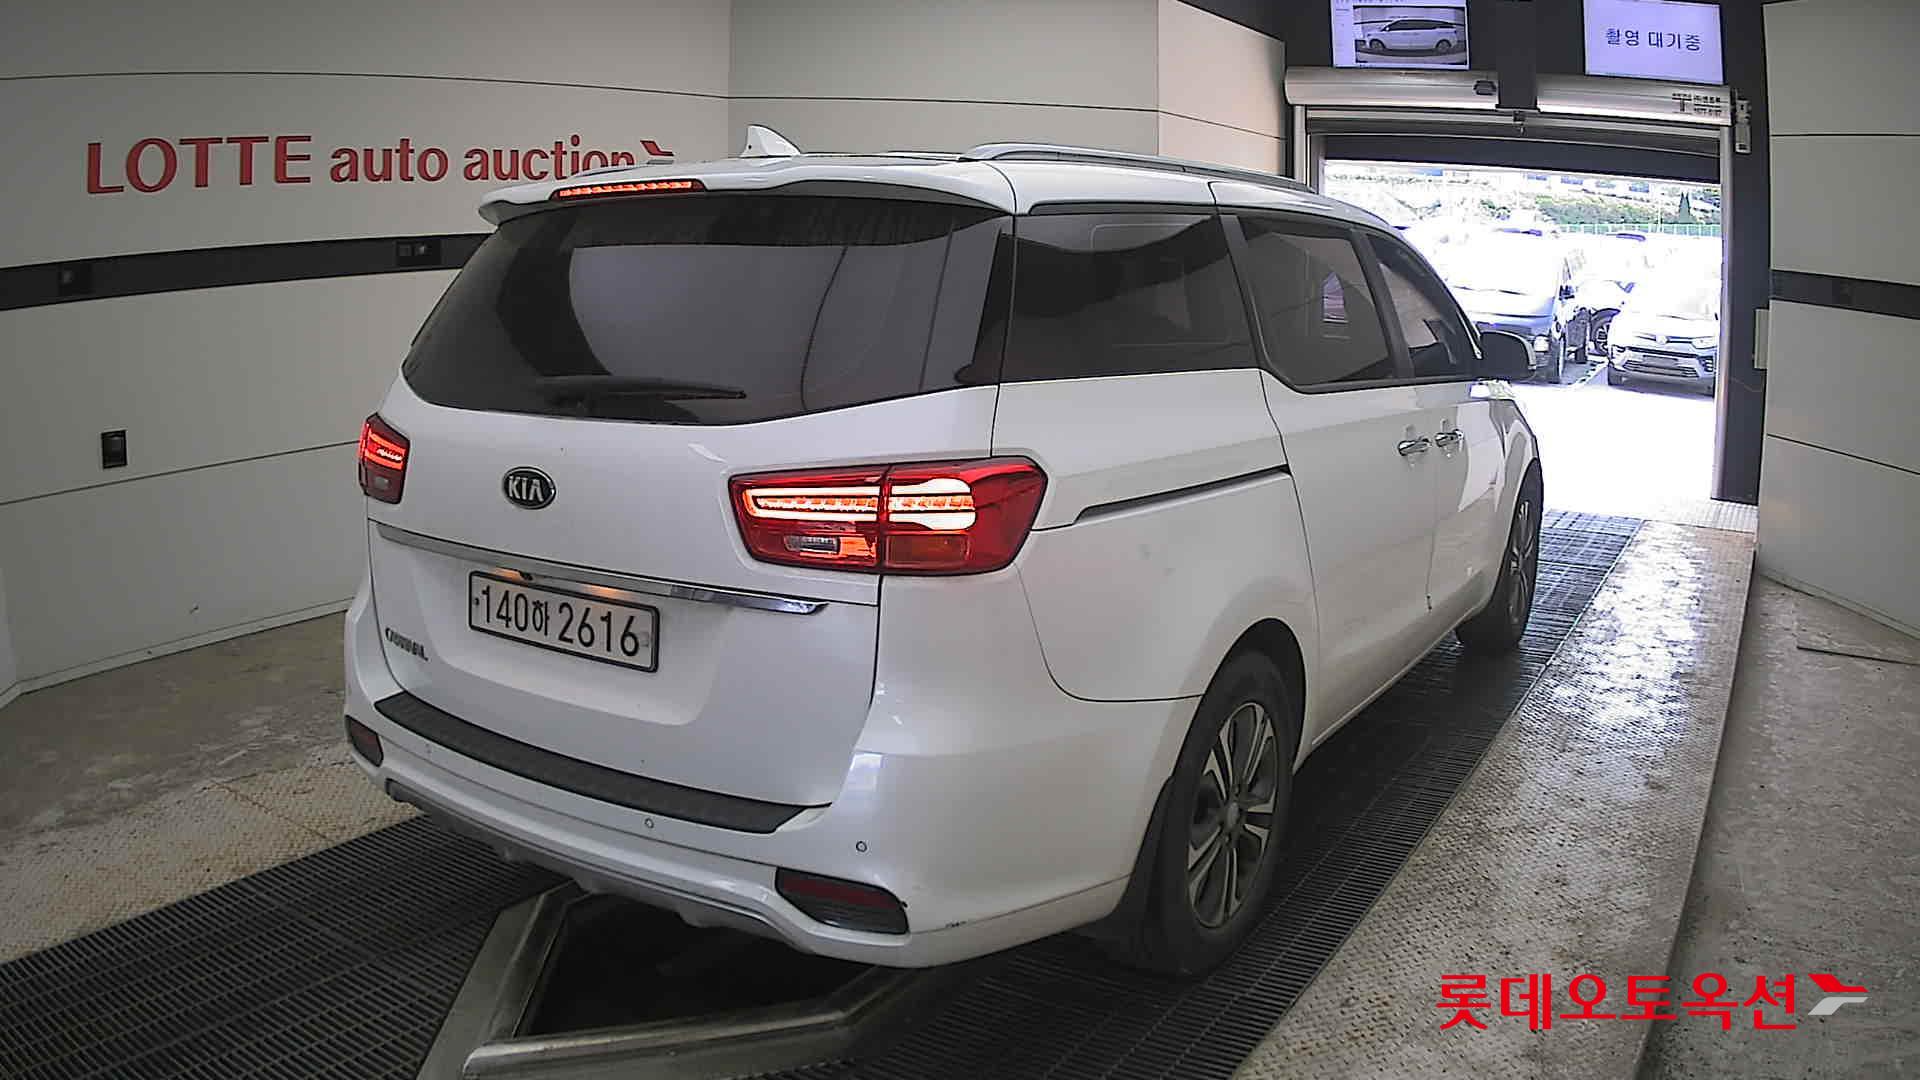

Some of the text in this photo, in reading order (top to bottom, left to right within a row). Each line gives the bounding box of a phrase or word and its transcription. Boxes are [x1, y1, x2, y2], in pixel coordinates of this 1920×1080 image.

[1647, 31, 1701, 51] 대기중
[87, 135, 312, 193] LOTTE
[330, 137, 449, 183] auto
[508, 475, 544, 502] KIA
[558, 601, 639, 657] 2616
